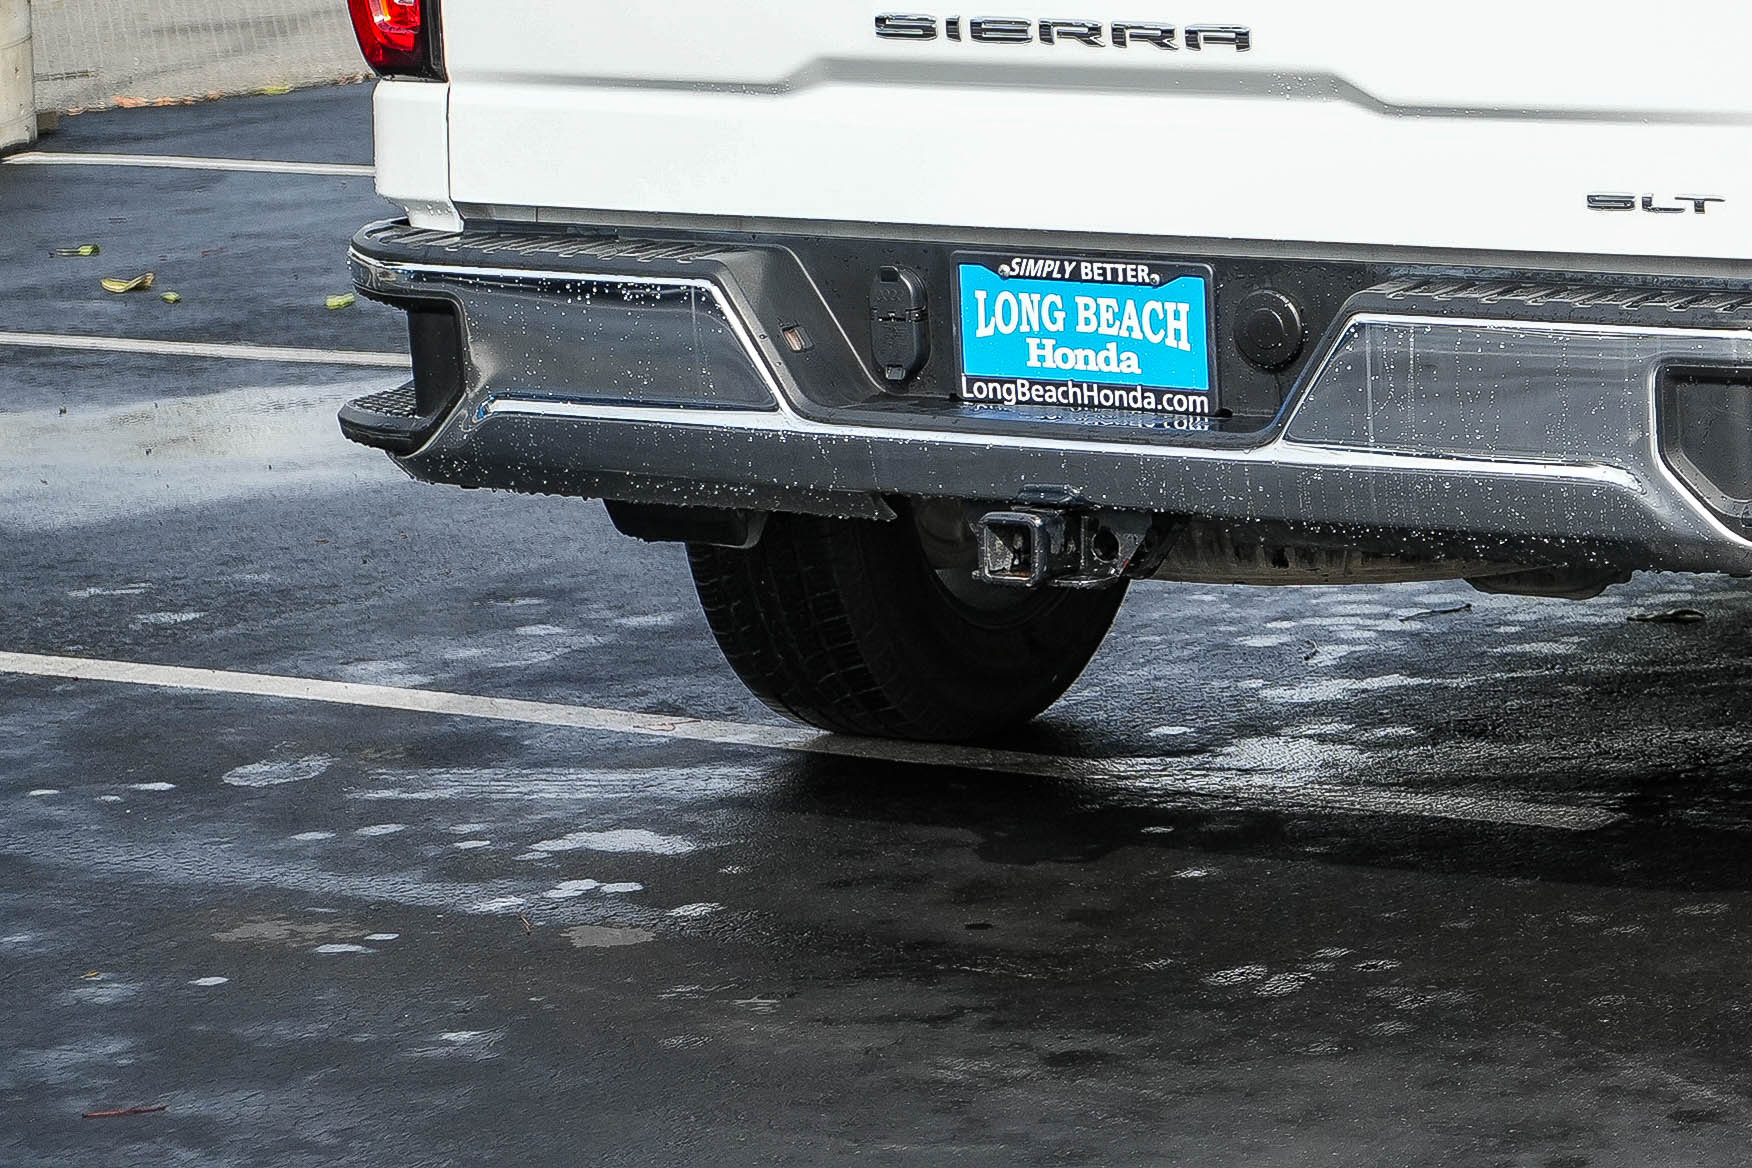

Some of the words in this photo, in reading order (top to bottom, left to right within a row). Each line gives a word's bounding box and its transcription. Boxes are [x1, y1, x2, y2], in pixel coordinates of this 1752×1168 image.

[873, 12, 1253, 53] SIERRA
[1586, 192, 1726, 214] SLT
[1010, 257, 1078, 279] SIMPLY
[1080, 263, 1150, 283] BETTER
[974, 289, 1066, 338] LONG
[1074, 295, 1192, 352] BEACH
[1025, 336, 1143, 375] Honda
[961, 373, 1209, 414] LongBeachHonda.com
